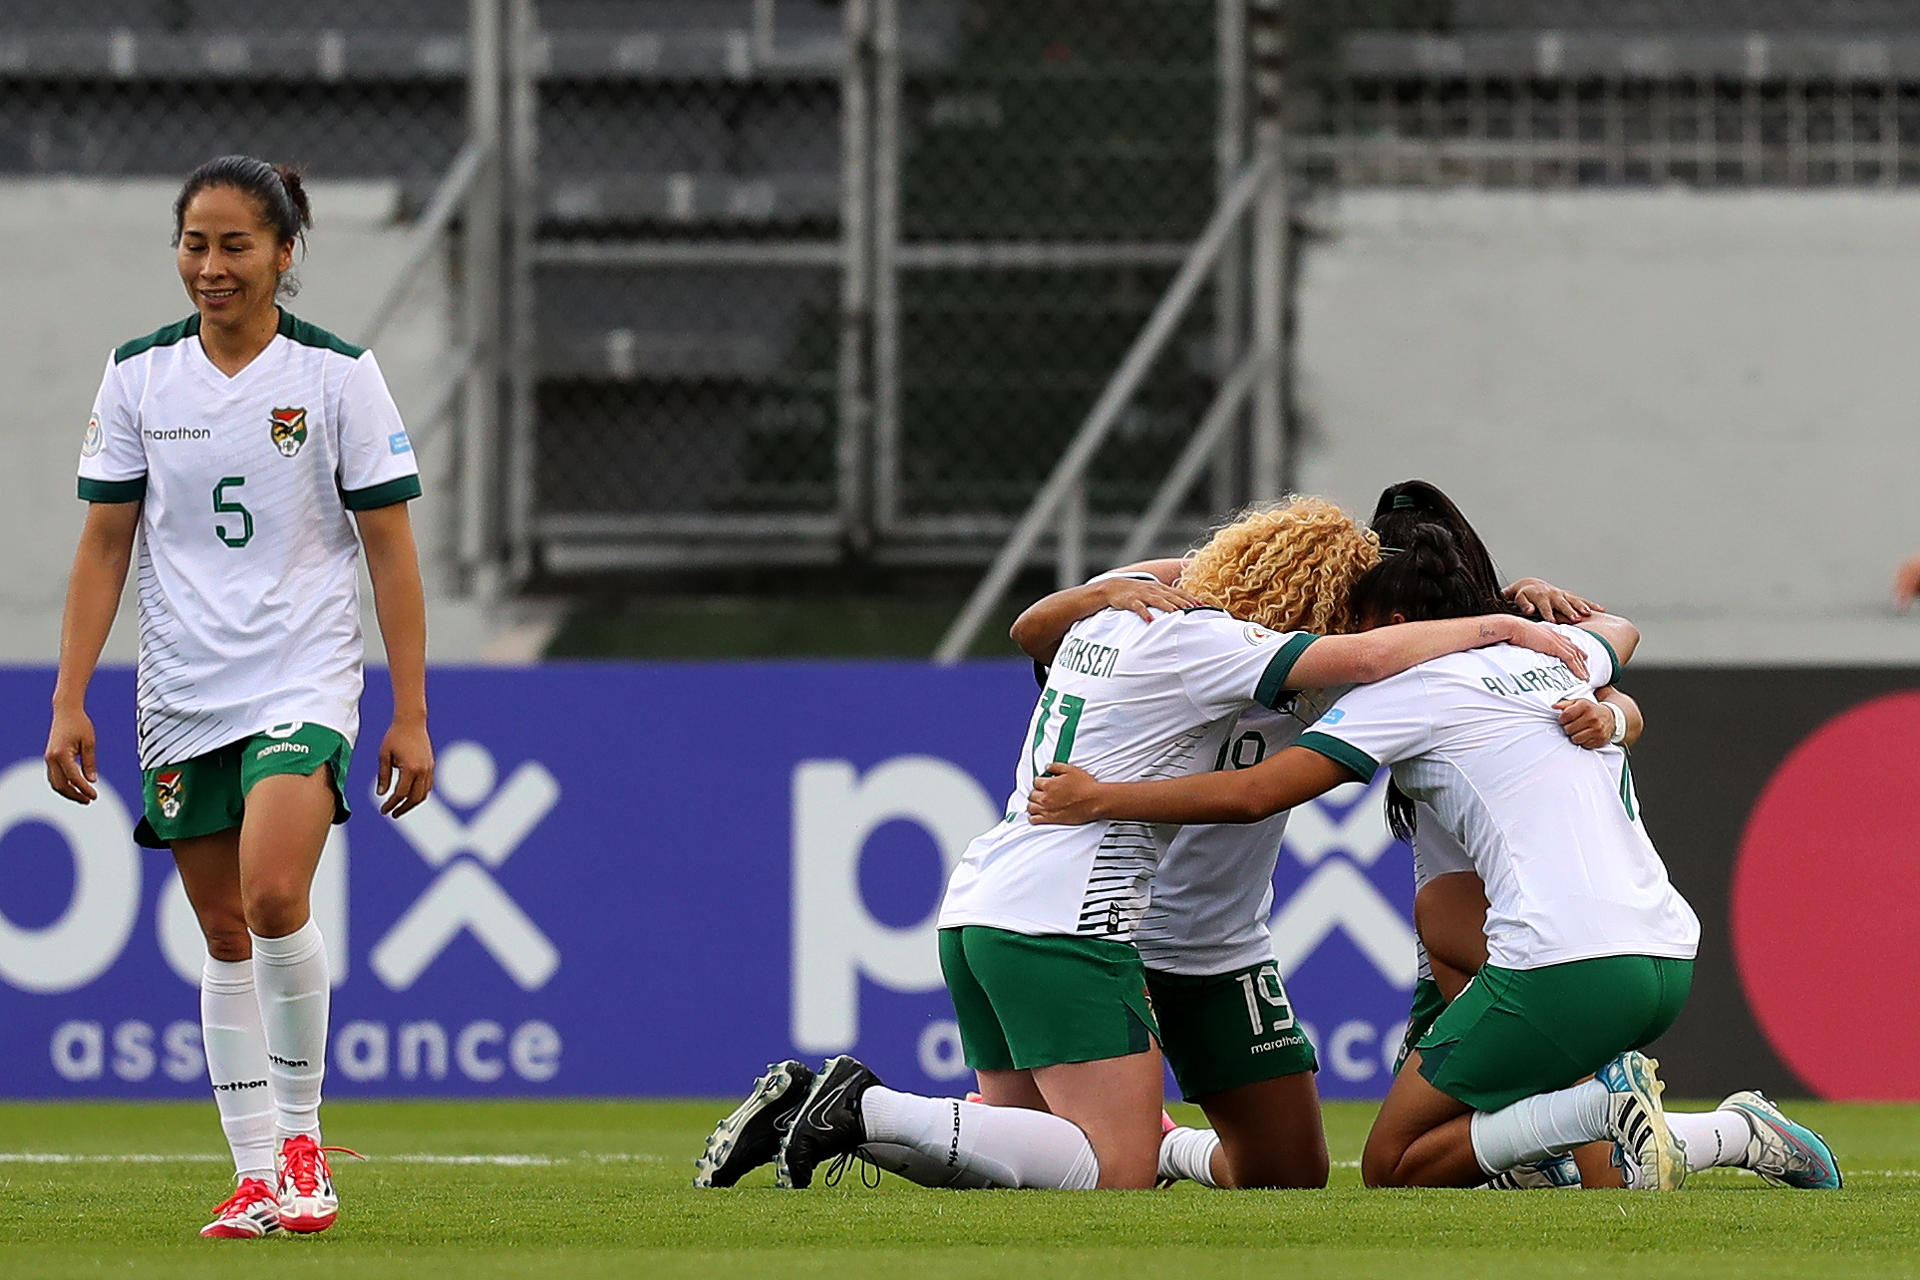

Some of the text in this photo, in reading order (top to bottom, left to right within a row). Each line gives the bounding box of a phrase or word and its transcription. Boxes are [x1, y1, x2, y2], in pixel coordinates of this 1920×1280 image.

[212, 476, 254, 548] 5
[1234, 965, 1295, 1036] 19
[50, 1020, 562, 1082] assance
[1250, 1035, 1305, 1055] marathon
[212, 1080, 268, 1092] rathon
[946, 1101, 960, 1168] marath
